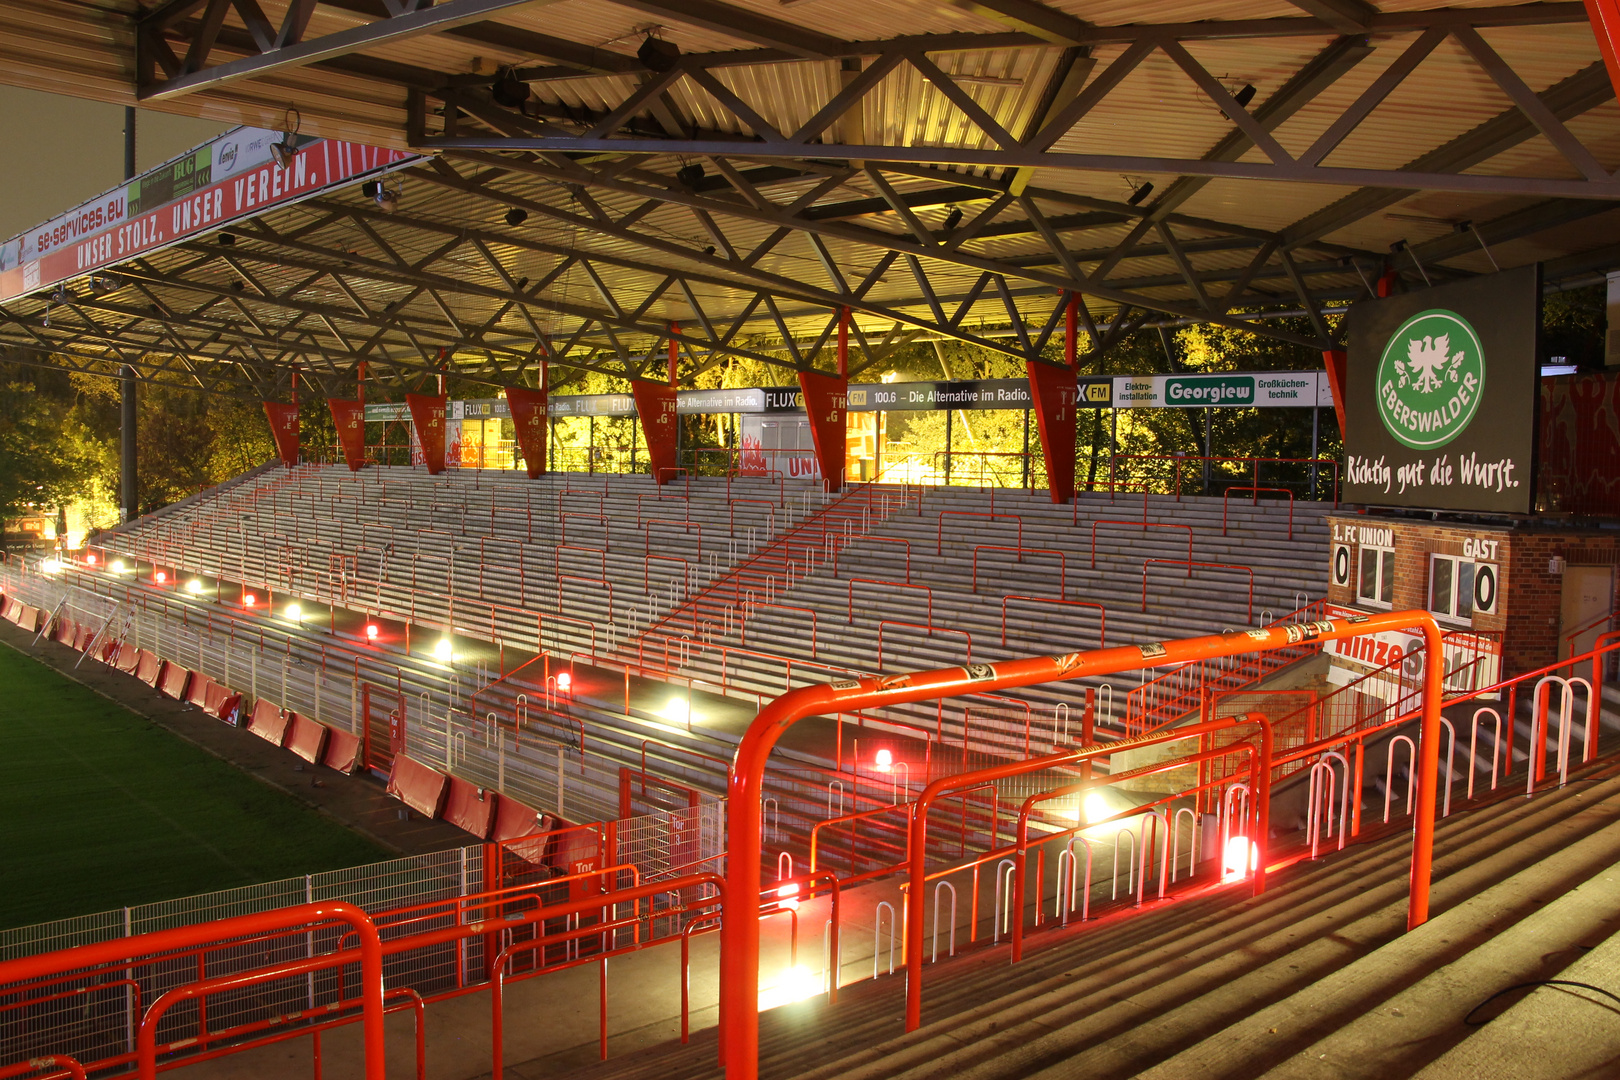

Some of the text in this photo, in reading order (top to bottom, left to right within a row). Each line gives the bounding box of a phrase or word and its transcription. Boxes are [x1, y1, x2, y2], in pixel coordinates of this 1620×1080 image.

[77, 152, 317, 269] UNSER STOLZ. UNSER VEREIN.
[1125, 382, 1152, 391] Elektro-
[1258, 379, 1309, 390] Großküchen-
[766, 392, 796, 408] FLUX
[852, 392, 865, 404] FM
[874, 391, 896, 403] 100.6
[909, 391, 924, 402] Die
[927, 388, 978, 402] Alternative
[982, 389, 994, 401] im
[998, 388, 1030, 401] Radio.
[1091, 387, 1106, 398] FM
[1119, 391, 1158, 400] installation
[1169, 383, 1250, 403] Georgiew
[1268, 389, 1298, 399] technik
[612, 400, 635, 411] FLUX
[687, 397, 722, 407] Alternative
[724, 396, 733, 406] im
[735, 395, 758, 406] Radio.
[1381, 371, 1478, 433] EBERSWALDER
[465, 404, 482, 416] FLUX
[1347, 455, 1391, 494] Richtig
[1397, 459, 1425, 495] gut
[1430, 454, 1453, 486] die
[1333, 524, 1393, 547] 1. FC UNION
[1463, 538, 1498, 560] GAST
[1335, 546, 1349, 584] 0
[1475, 565, 1495, 611] 0
[1335, 634, 1403, 670] Hinze
[672, 816, 685, 831] Tor
[675, 834, 681, 846] 3
[576, 861, 594, 874] Tor
